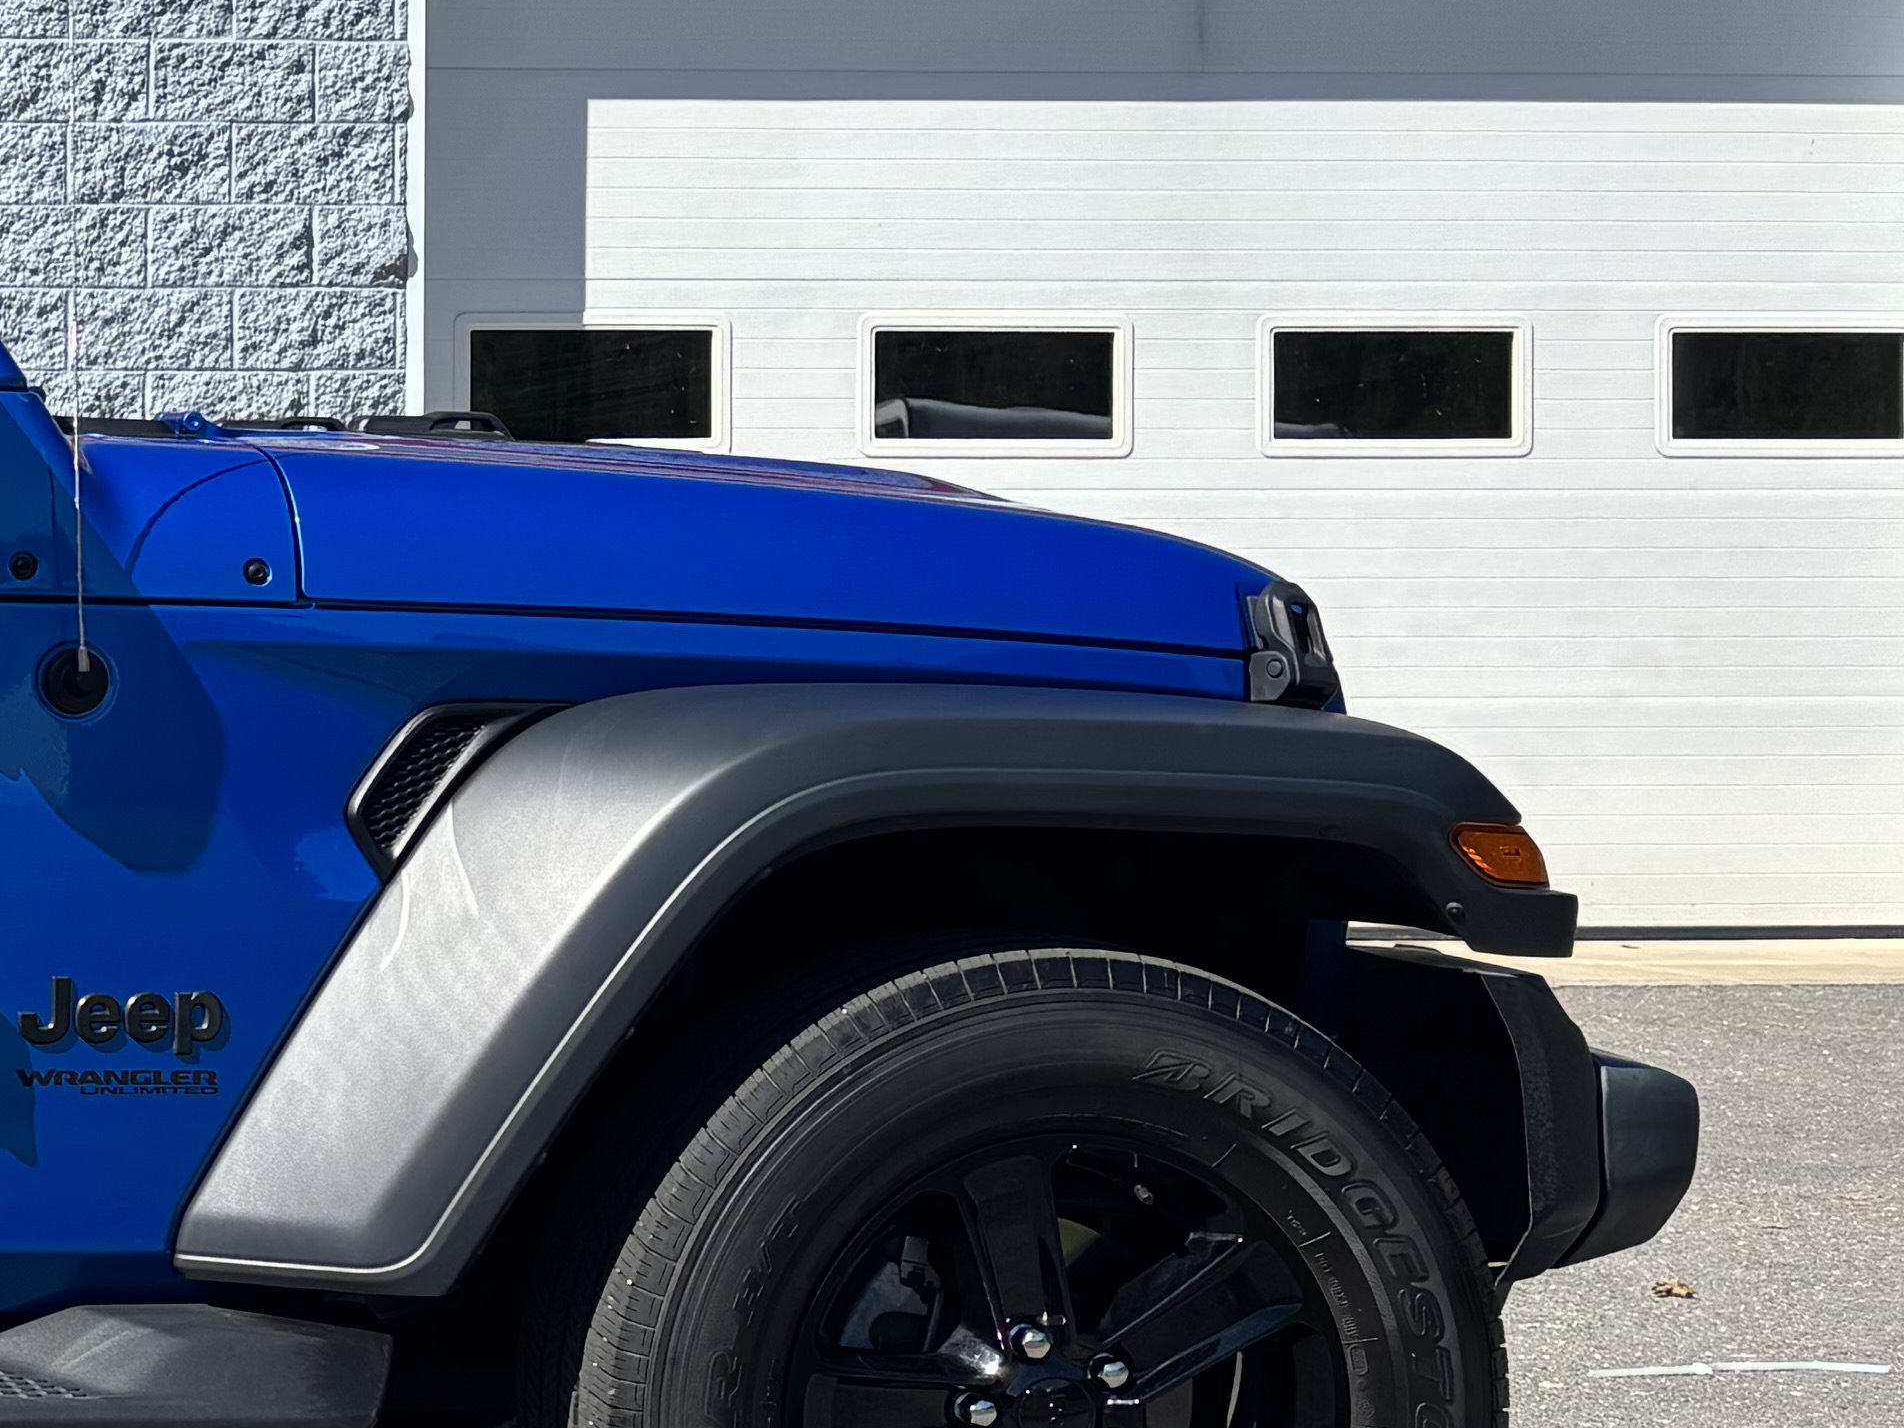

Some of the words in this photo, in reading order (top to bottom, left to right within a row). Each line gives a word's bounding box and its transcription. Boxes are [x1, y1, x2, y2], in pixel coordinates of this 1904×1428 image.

[17, 976, 224, 1056] Jeep
[16, 1069, 218, 1086] WRANGLER
[80, 1085, 218, 1096] UNLIMITED
